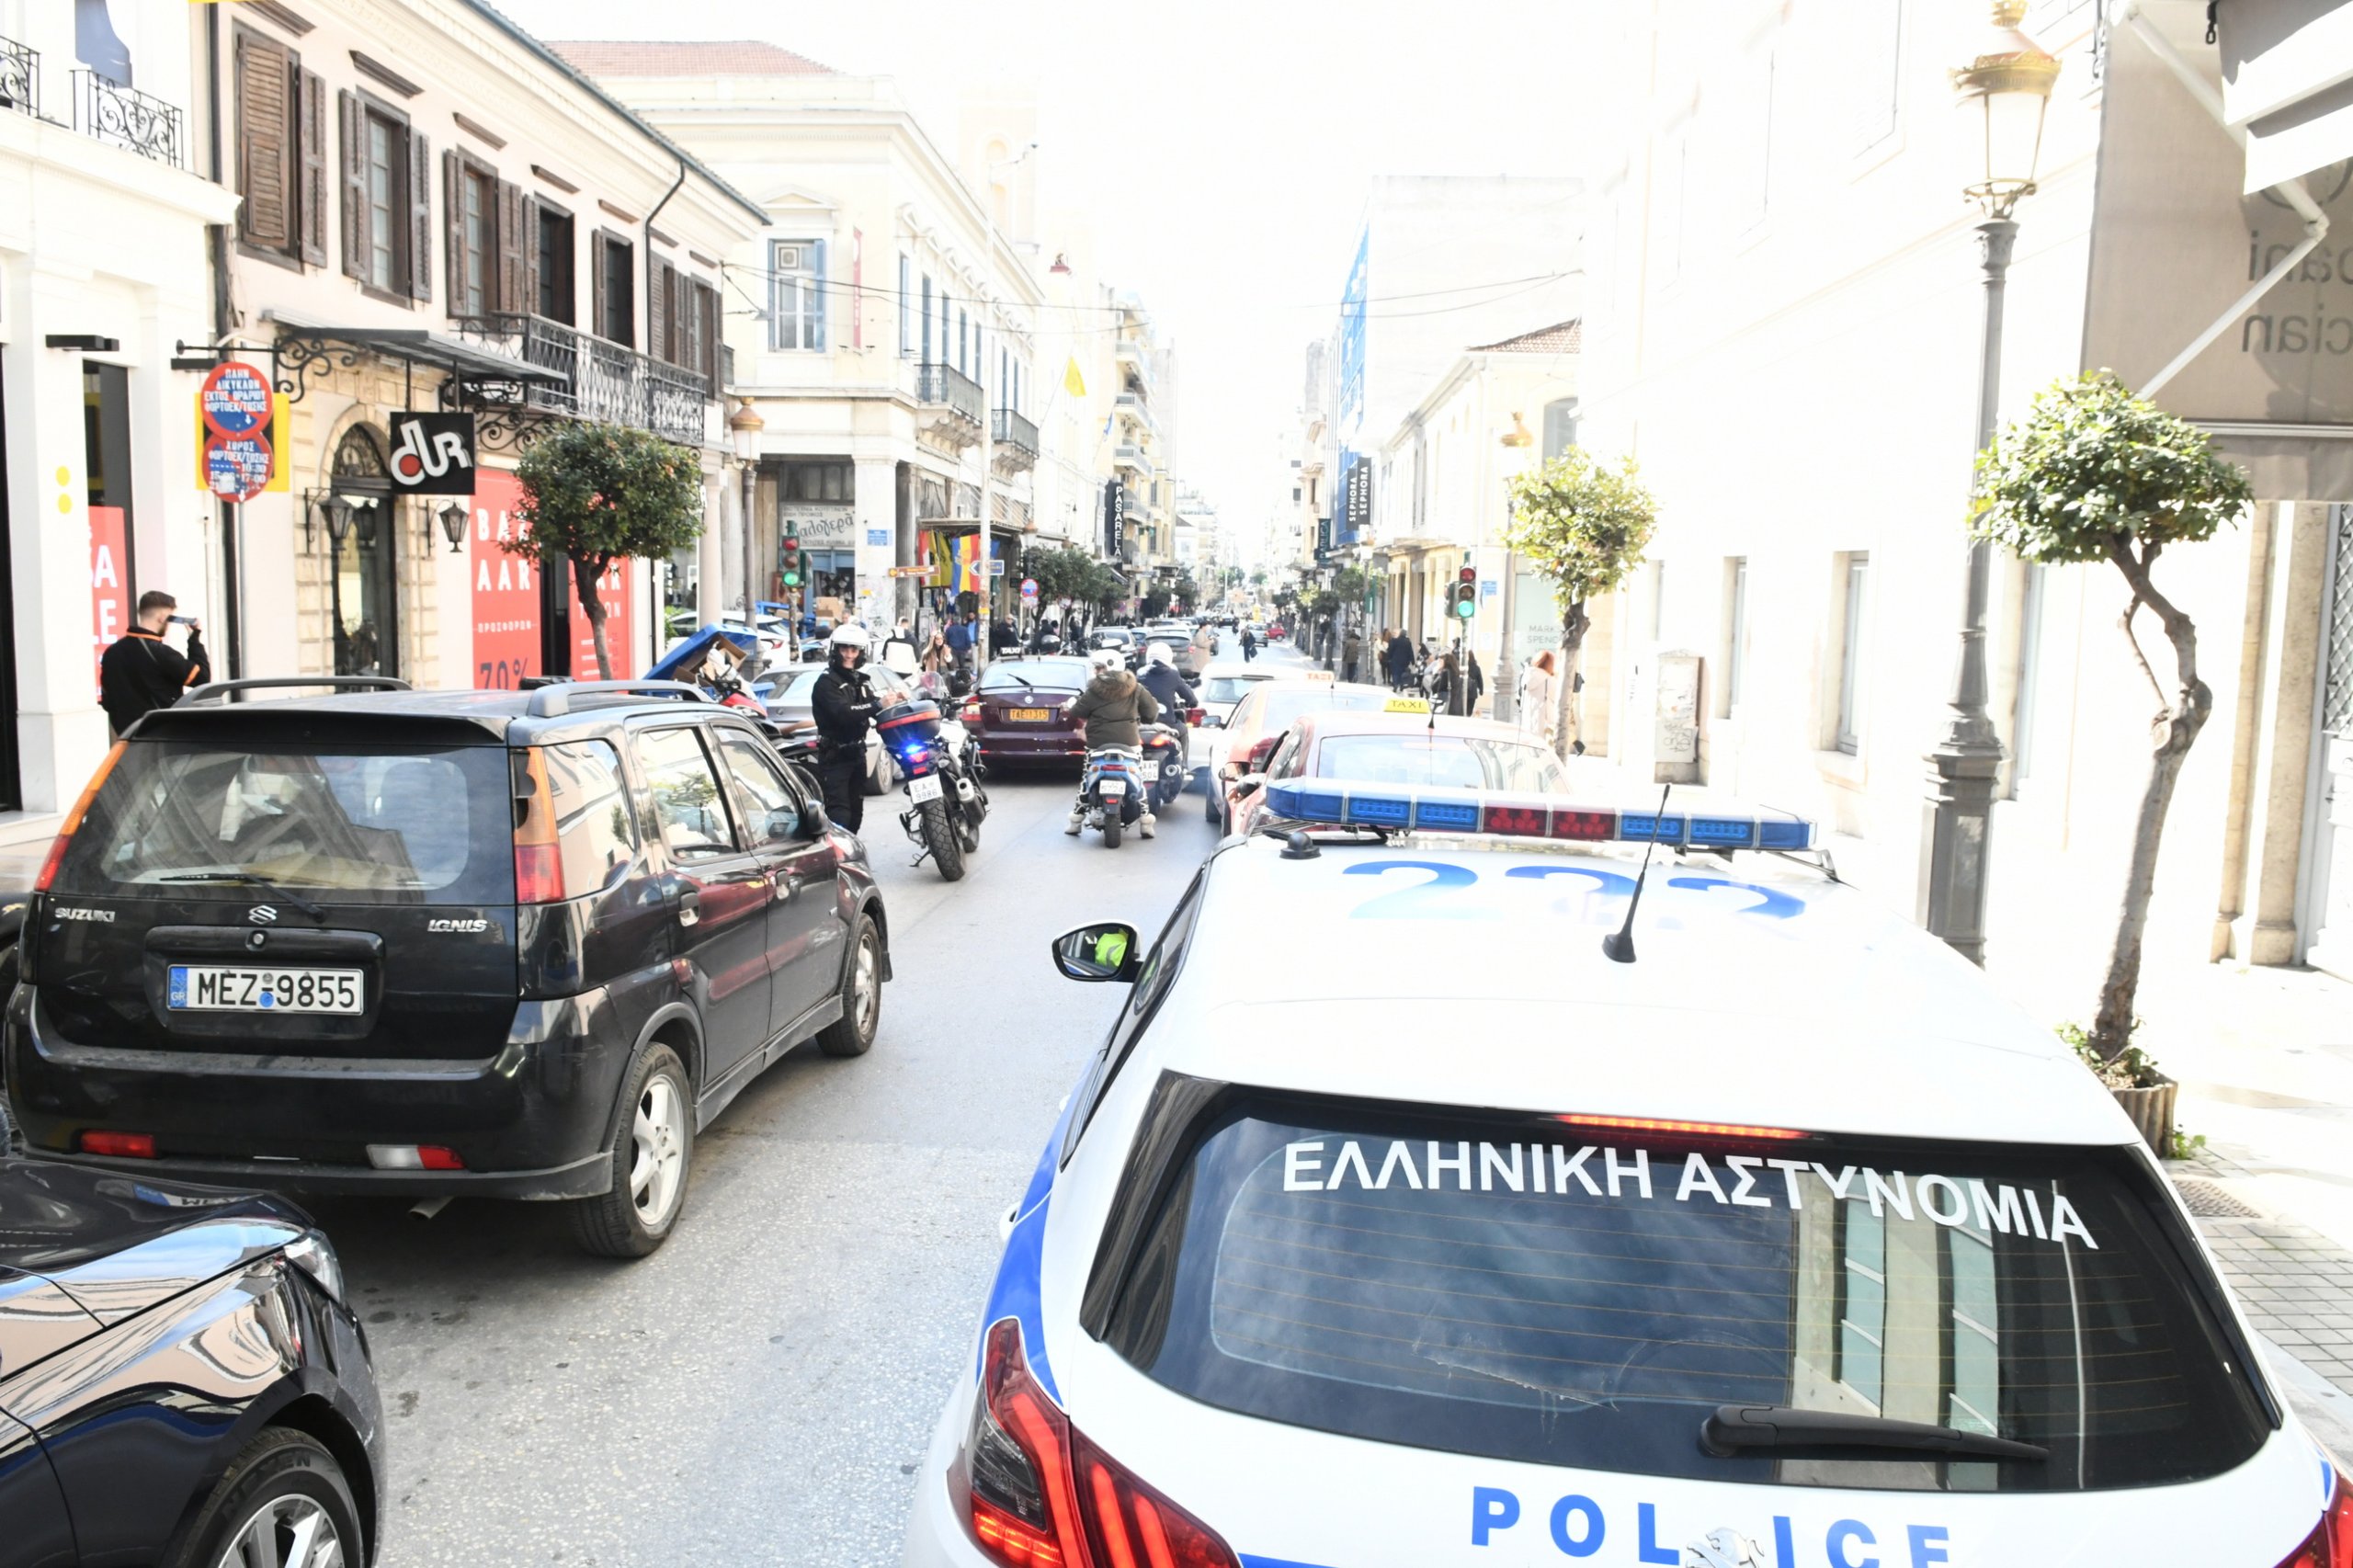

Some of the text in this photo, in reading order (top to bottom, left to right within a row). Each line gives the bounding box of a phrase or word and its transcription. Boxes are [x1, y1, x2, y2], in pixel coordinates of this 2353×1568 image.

[224, 369, 250, 379] ΠΛΗΝ
[1348, 476, 1358, 522] SEPHORA
[1359, 466, 1369, 516] SEPHORA
[1114, 485, 1123, 557] PASARELA
[90, 544, 118, 588] A
[476, 559, 530, 591] AAR
[93, 599, 118, 644] E
[1391, 699, 1423, 709] TAXI
[54, 907, 116, 923] SUZUKI
[426, 918, 488, 934] IGNIS
[1283, 1139, 2100, 1250] ΕΛΛΗΝΙΚΗ ΑΣΤΥΝΟΜΙΑ
